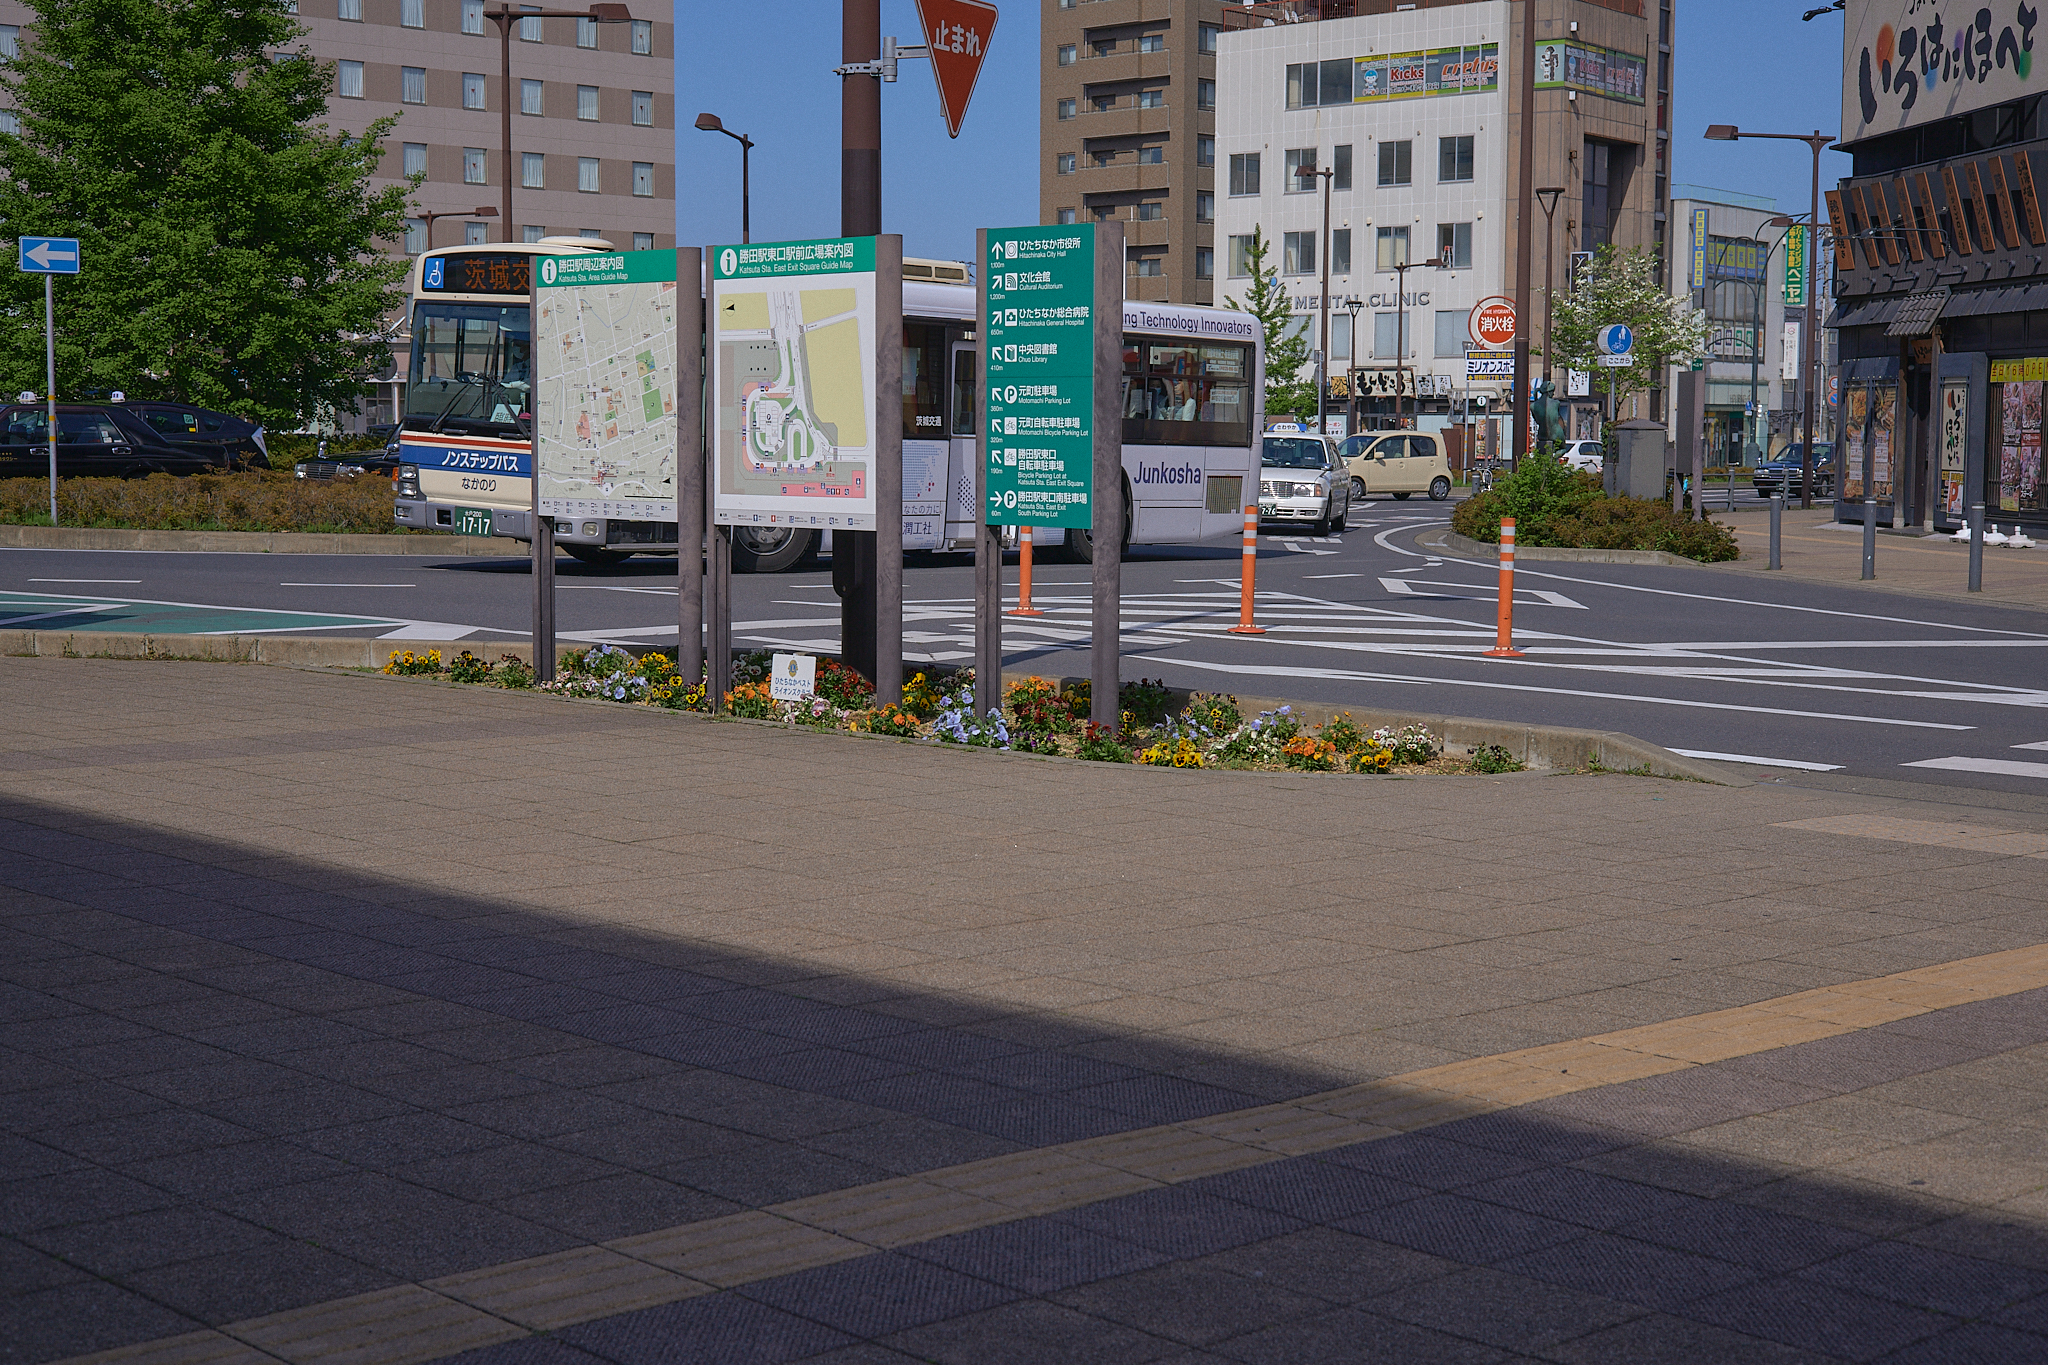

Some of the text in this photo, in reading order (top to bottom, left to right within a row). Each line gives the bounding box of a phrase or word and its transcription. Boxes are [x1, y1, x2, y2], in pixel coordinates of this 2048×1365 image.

[933, 20, 981, 57] 止まれ
[1859, 0, 2038, 124] いろはにほへと
[1391, 66, 1424, 81] Kicks
[1020, 237, 1081, 251] ひたちなか市役所
[739, 243, 853, 264] 勝田駅東口駅前広場案内図
[1047, 251, 1055, 259] City
[559, 256, 624, 273] 勝田駅周辺案内図
[739, 260, 853, 274] Katsuta Sta. East Exit Square Guide Map
[465, 259, 530, 291] 茨城交
[578, 274, 587, 282] Sta.
[616, 272, 628, 281] Map
[1020, 271, 1051, 283] 文化会館
[1788, 268, 1801, 297] ベニヤ
[1369, 292, 1430, 307] CLINIC
[1019, 306, 1089, 319] ひたちなか総合病院
[1140, 311, 1199, 333] Technology
[1201, 317, 1252, 334] Innovators
[1481, 316, 1515, 332] 消火栓
[1019, 343, 1057, 355] 中央図書館
[1032, 356, 1047, 364] Library
[1019, 385, 1057, 396] 元町駐車場
[916, 416, 942, 426] 茨城交通
[1018, 417, 1080, 429] 元町自転車駐車場
[1018, 449, 1056, 459] 勝田駅東口
[442, 451, 519, 472] ノンステップバス
[1018, 460, 1064, 471] 自転車駐車場
[1035, 472, 1052, 480] Parking
[1133, 461, 1201, 485] Junkosha
[462, 477, 497, 492] なかのり
[1018, 491, 1087, 504] 勝田駅東口南駐車場
[1032, 510, 1049, 518] Parking
[463, 516, 490, 534] 17-17
[902, 521, 932, 535] 潤工社
